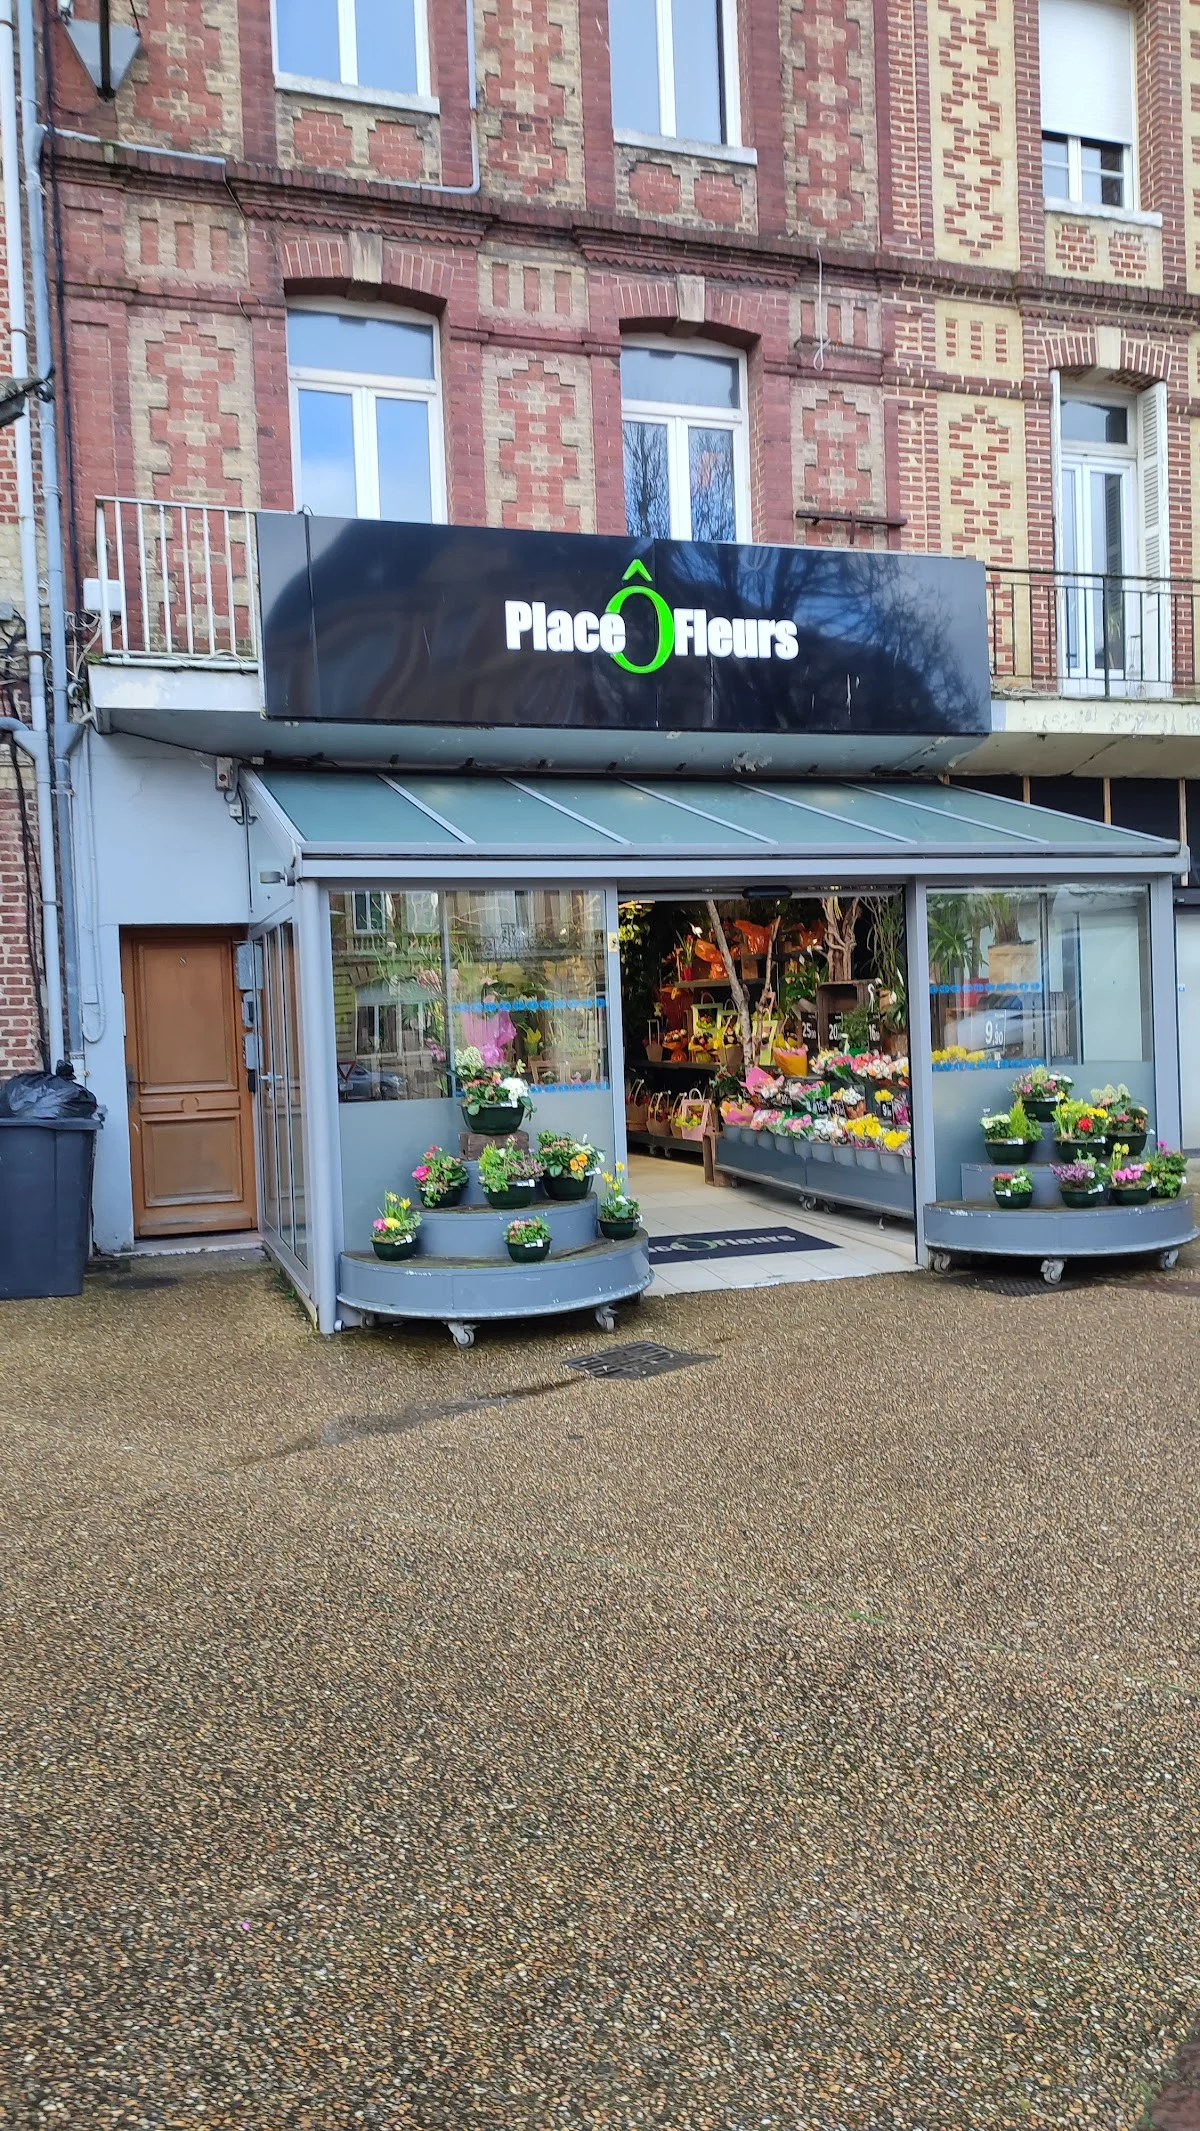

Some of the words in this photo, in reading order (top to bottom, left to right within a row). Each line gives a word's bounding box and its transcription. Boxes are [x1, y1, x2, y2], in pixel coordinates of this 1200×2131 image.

[505, 600, 627, 654] Place
[604, 559, 675, 674] Ô
[673, 608, 799, 660] Fleurs
